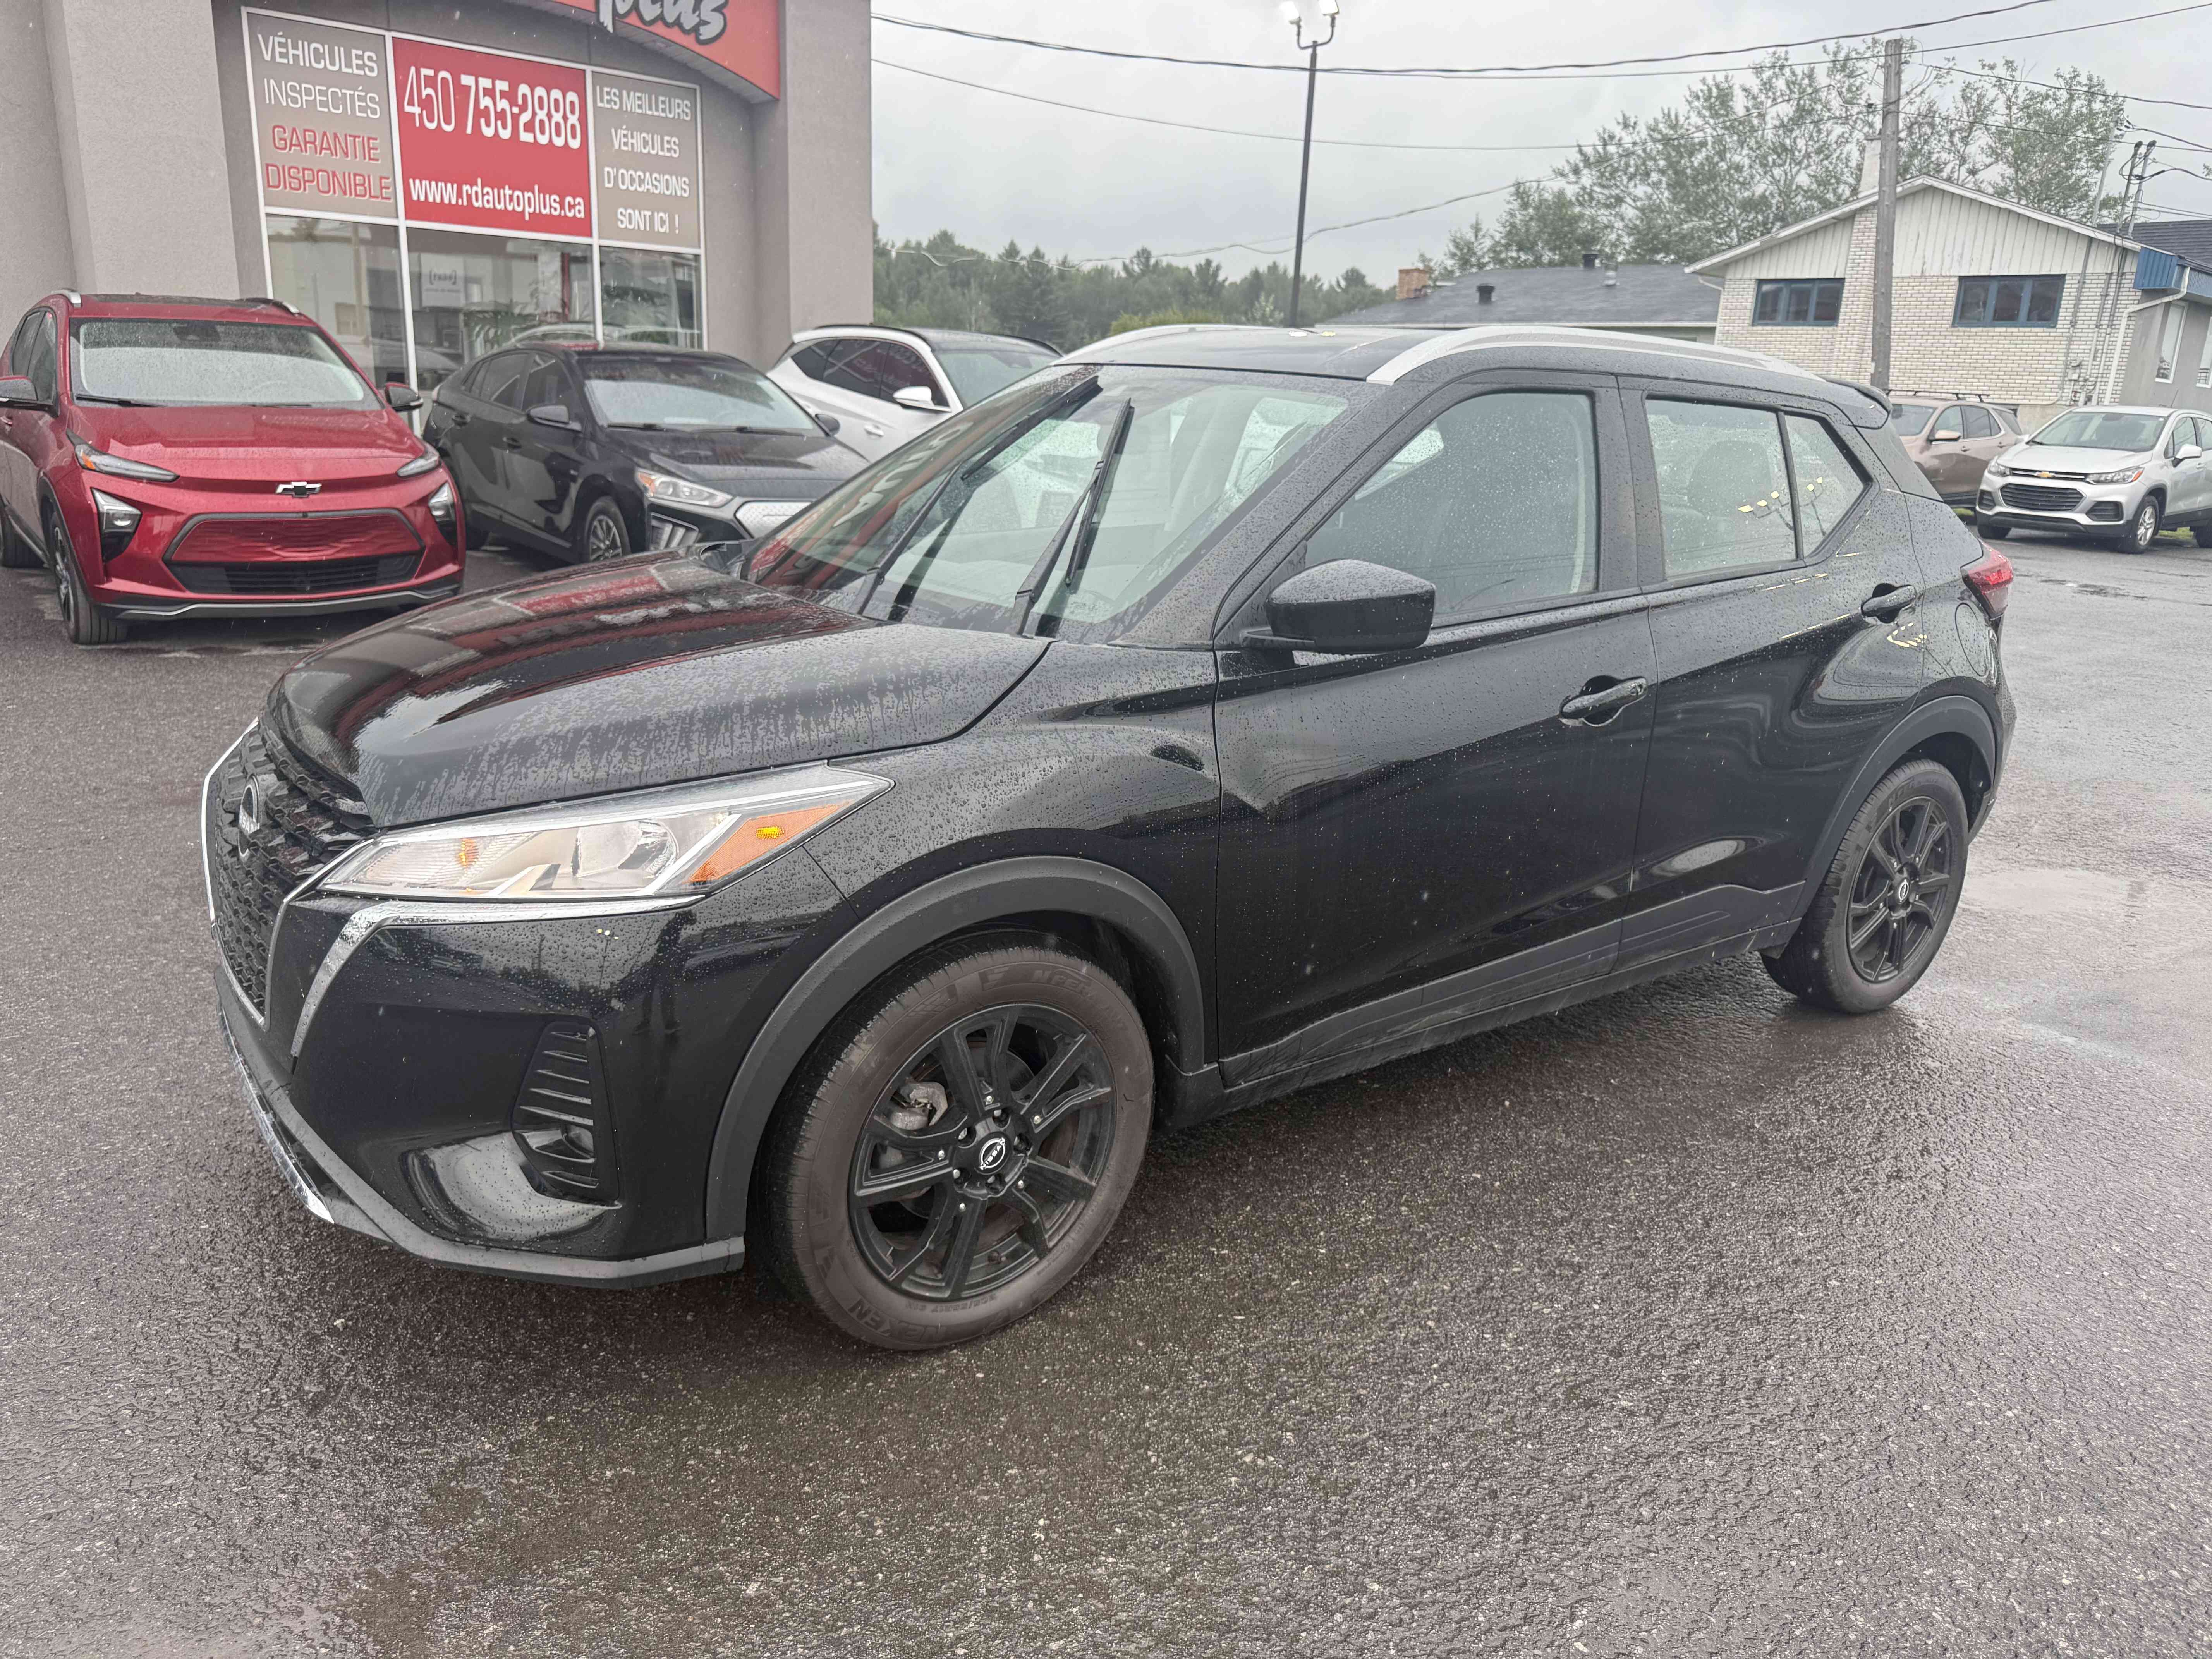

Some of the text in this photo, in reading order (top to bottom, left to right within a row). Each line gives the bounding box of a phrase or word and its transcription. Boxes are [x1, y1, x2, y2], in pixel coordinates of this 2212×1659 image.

[258, 31, 378, 77] VÉHICULES
[264, 78, 381, 119] INSPECTÉS
[404, 65, 581, 149] 450 755-2888
[596, 85, 692, 121] LES MEILLEURS
[272, 125, 381, 164] GARANTIE
[611, 124, 680, 158] VÉHICULES
[265, 163, 393, 202] DISPONIBLE
[409, 177, 585, 221] www.rdautoplus.ca
[617, 207, 679, 234] SONT ICI !
[979, 1137, 1005, 1170] NISSAN
